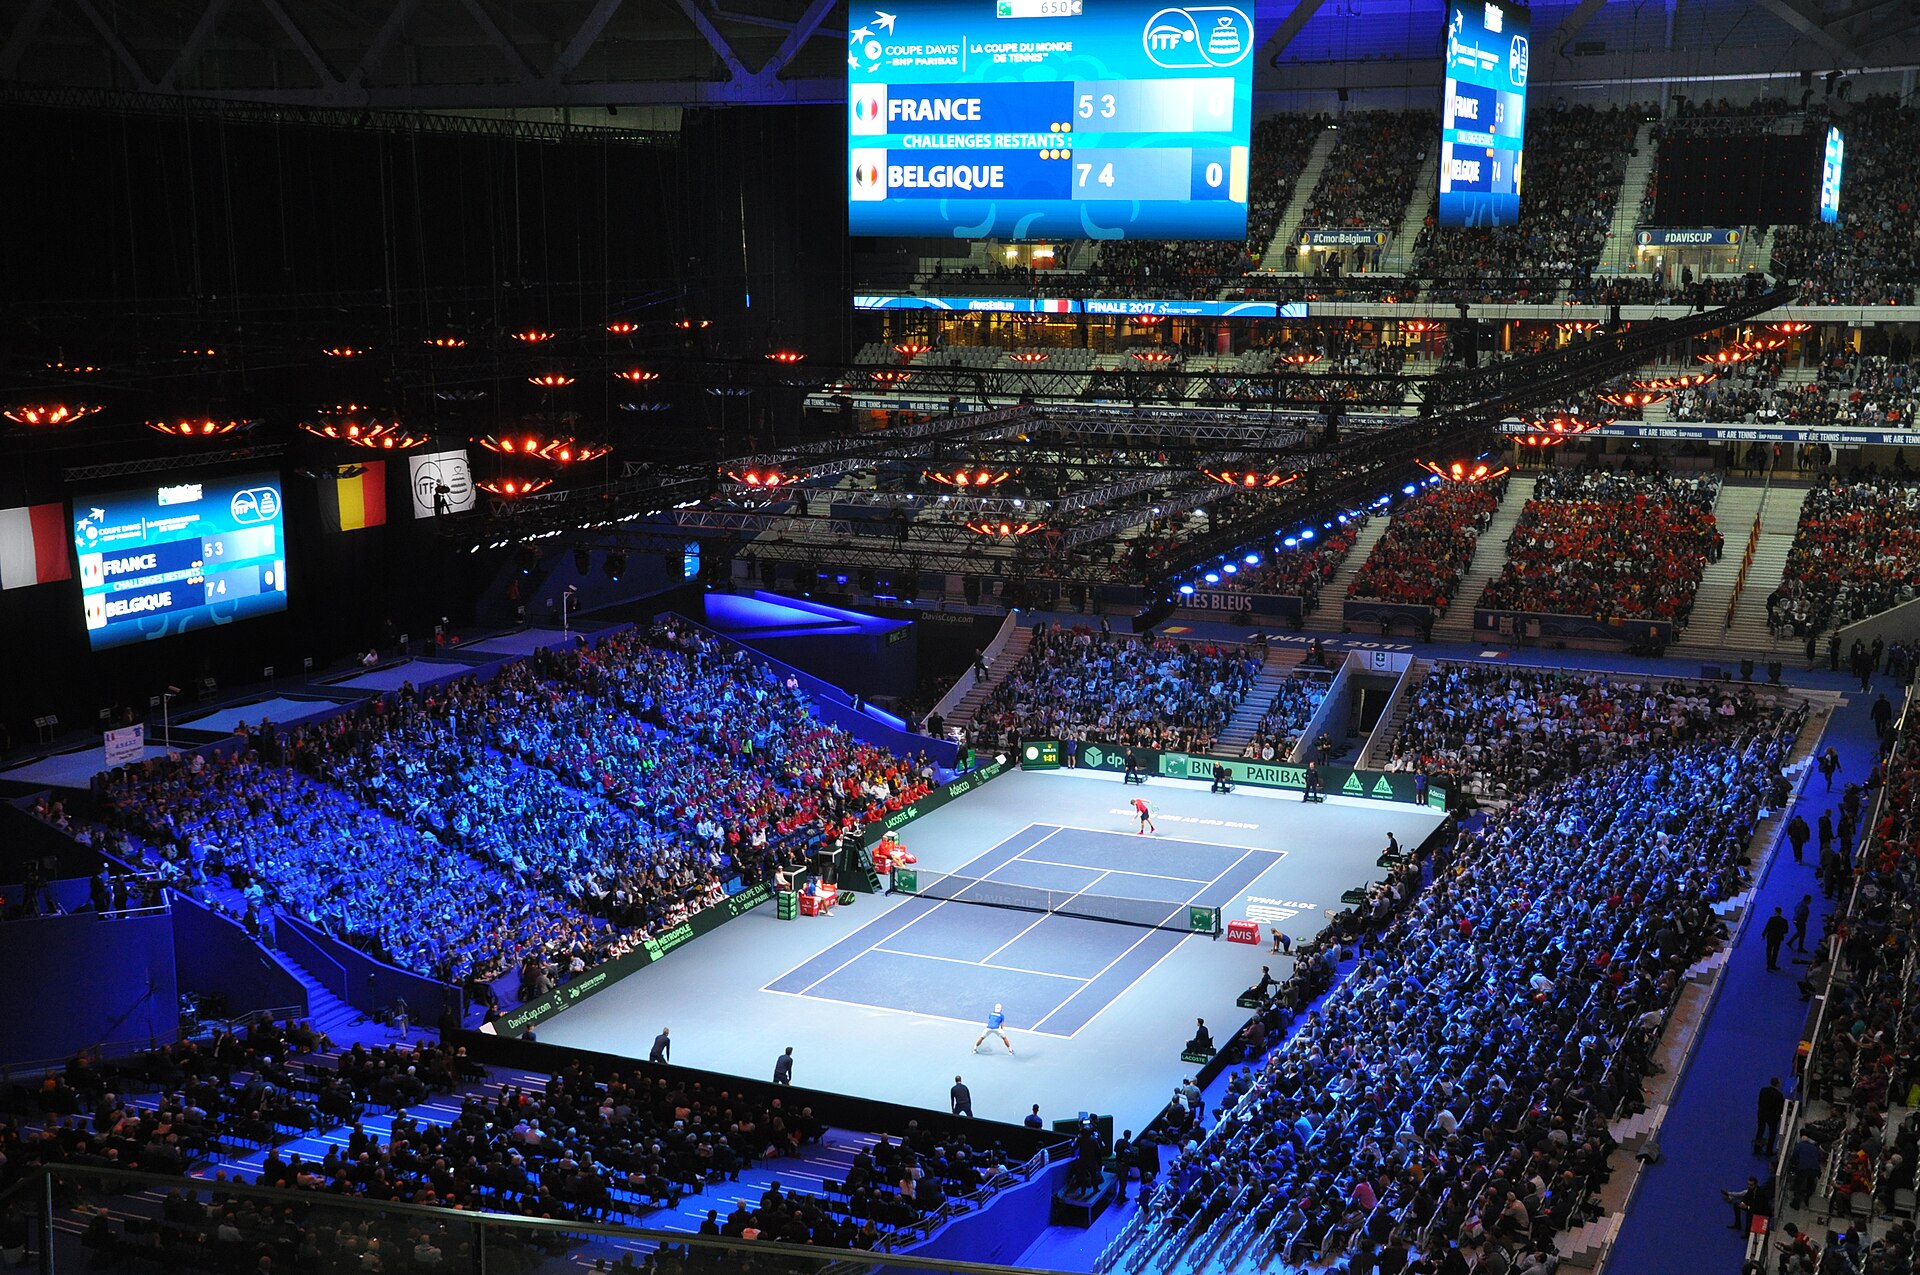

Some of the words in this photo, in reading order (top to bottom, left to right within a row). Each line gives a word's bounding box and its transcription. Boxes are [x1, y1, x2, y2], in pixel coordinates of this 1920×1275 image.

[970, 43, 984, 54] LA
[984, 43, 1018, 54] COUPE
[1019, 43, 1034, 53] DU
[1035, 42, 1073, 52] MONDE
[1152, 33, 1181, 51] ITF
[885, 46, 923, 56] COUPE
[915, 56, 959, 66] PARIBAS
[993, 54, 1007, 64] DE
[888, 98, 982, 122] FRANCE
[1078, 94, 1094, 119] 5
[1100, 94, 1116, 118] 3
[1455, 95, 1479, 120] FRANCE
[902, 134, 992, 148] CHALLENGES
[994, 133, 1065, 147] RESTANTS
[888, 165, 1004, 191] BELGIQUE
[1076, 163, 1092, 188] 7
[1098, 162, 1115, 188] 4
[1205, 162, 1223, 188] 0
[1451, 158, 1480, 184] BELGIQUE
[1313, 233, 1371, 246] #CmonBelgium
[1664, 232, 1713, 243] #DAVISCUP
[1087, 301, 1127, 313] FINALE
[1129, 302, 1156, 314] 2017
[1508, 423, 1526, 432] TENNIS
[1638, 428, 1648, 436] WE
[1648, 429, 1658, 437] ARE
[1659, 429, 1677, 437] TENNIS
[1717, 430, 1726, 439] WE
[1726, 430, 1737, 439] ARE
[1738, 431, 1757, 439] TENNIS
[1798, 432, 1807, 441] WE
[1808, 432, 1819, 441] ARE
[1820, 433, 1839, 442] TENNIS
[1883, 434, 1892, 443] WE
[1892, 434, 1904, 443] ARE
[1905, 434, 1920, 444] TENN
[419, 481, 434, 496] ITF
[103, 553, 157, 576] FRANCE
[204, 543, 213, 558] 5
[214, 541, 224, 556] 3
[113, 574, 164, 592] CHALLENGES
[106, 591, 172, 617] BELGIQUE
[206, 581, 214, 597] 7
[216, 579, 227, 595] 4
[1186, 593, 1208, 609] LES
[1211, 594, 1252, 612] BLEUS
[921, 611, 974, 624] DavisCup.com
[1343, 639, 1413, 650] 2017
[1192, 761, 1214, 777] BN
[948, 781, 970, 797] Adecco
[1428, 788, 1446, 799] Adecco
[885, 811, 909, 829] LACOSTE
[735, 888, 756, 903] COUPE
[975, 893, 1012, 905] DAVIS
[1247, 895, 1282, 905] FINAL
[1284, 901, 1317, 910] 2017
[658, 923, 691, 947] MÉTROPOLE
[1229, 930, 1252, 940] AVIS
[508, 1002, 551, 1029] DavisCup.com
[1181, 1055, 1206, 1064] LACOSTE
